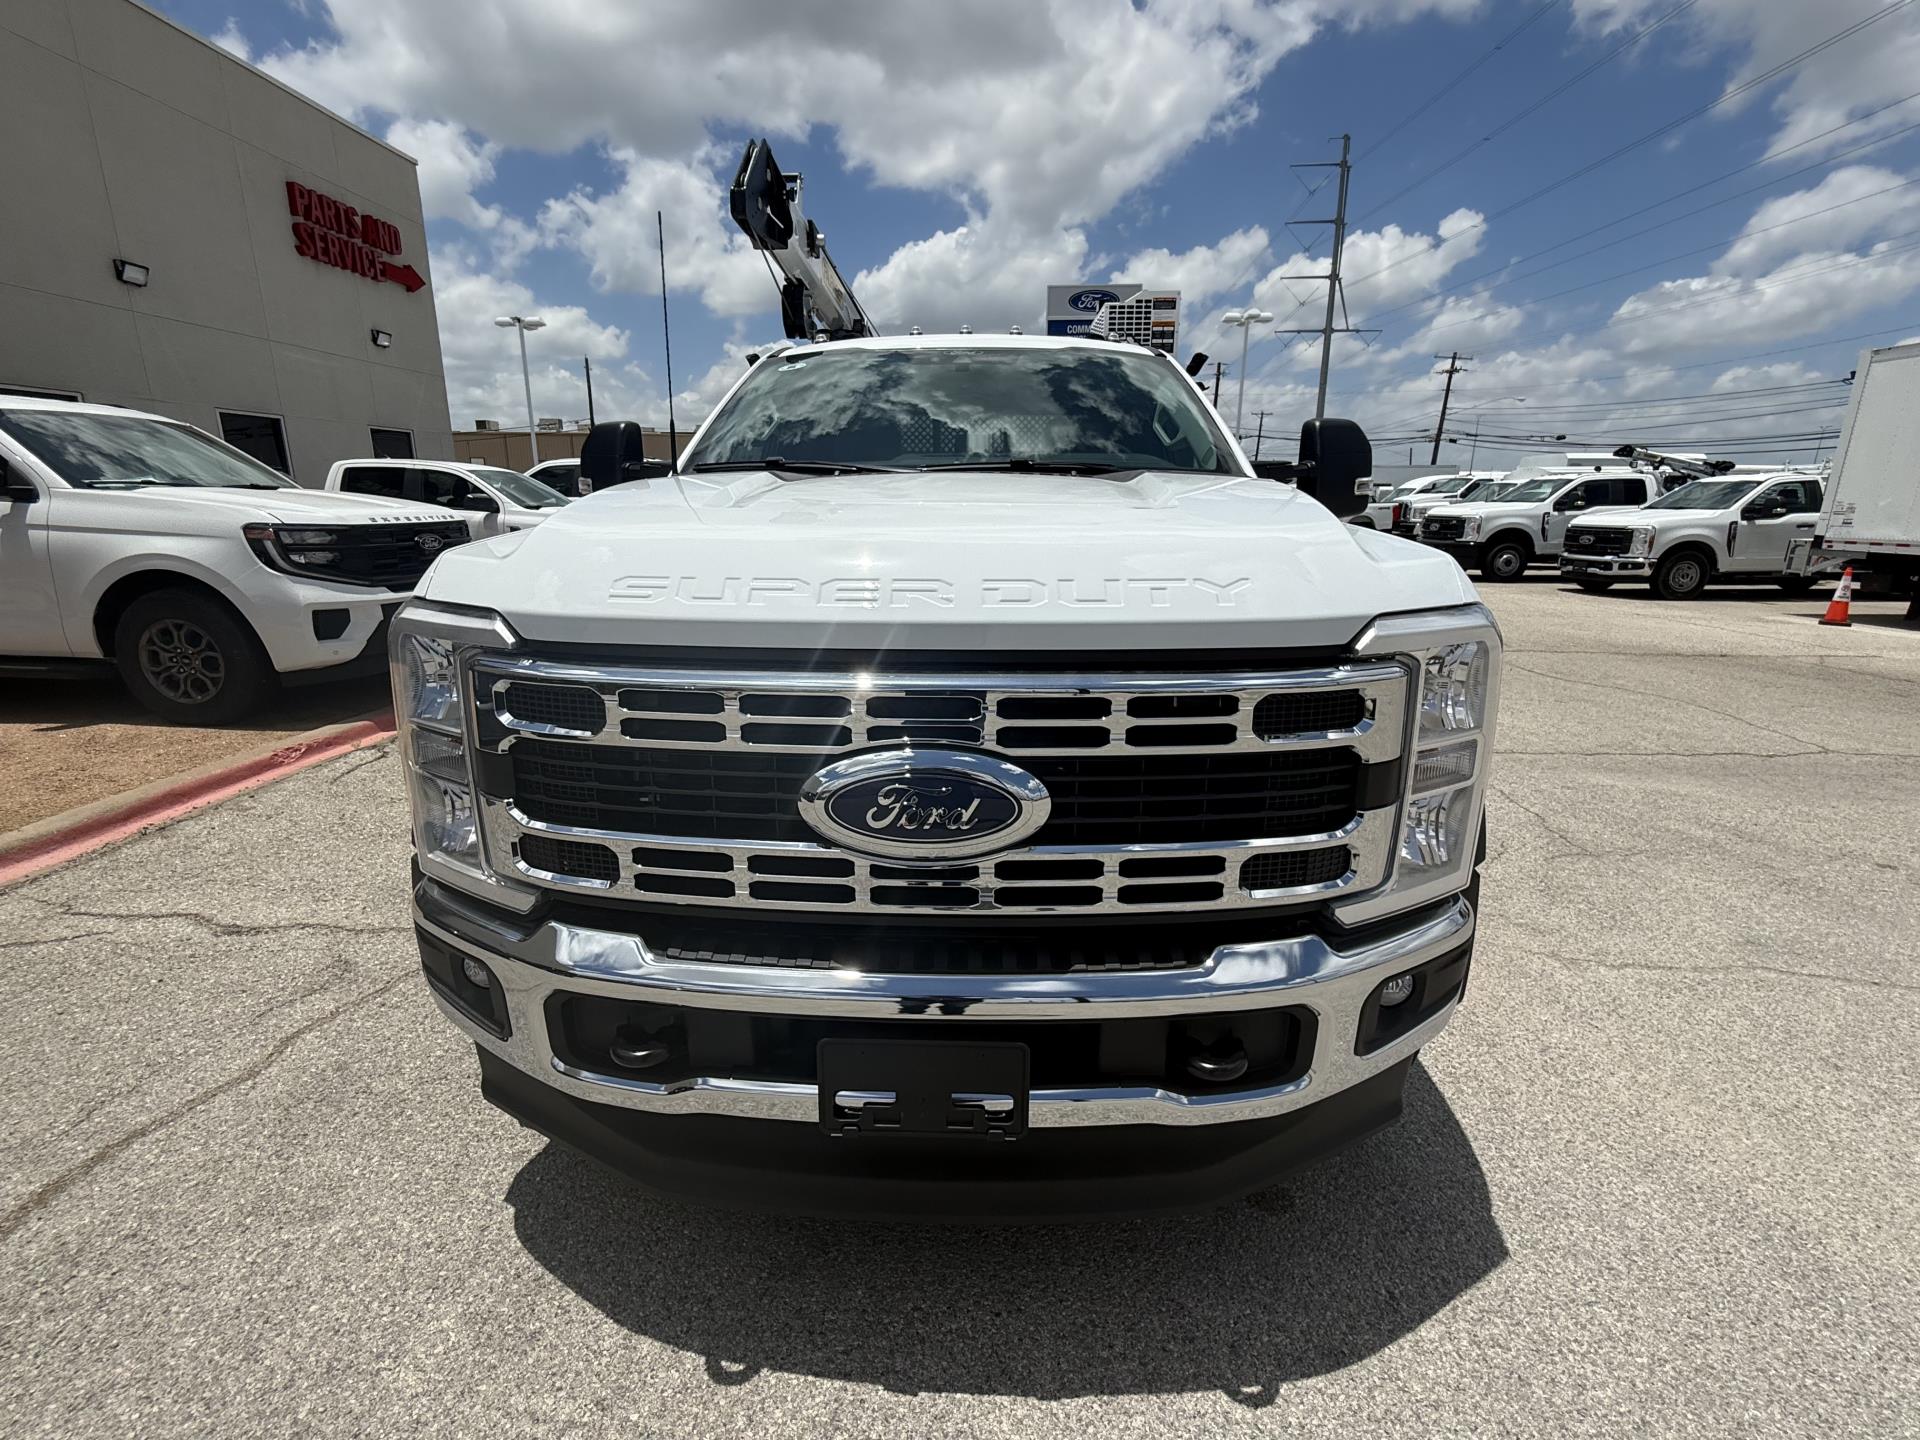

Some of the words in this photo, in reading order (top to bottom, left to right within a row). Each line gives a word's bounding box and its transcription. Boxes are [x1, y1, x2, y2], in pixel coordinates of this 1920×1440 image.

[286, 181, 360, 239] PARTS
[360, 214, 402, 256] AND
[292, 222, 387, 282] SERVICE
[1078, 293, 1108, 308] For
[607, 576, 955, 607] SUPER
[981, 577, 1252, 608] DUTY
[865, 783, 982, 830] Ford
